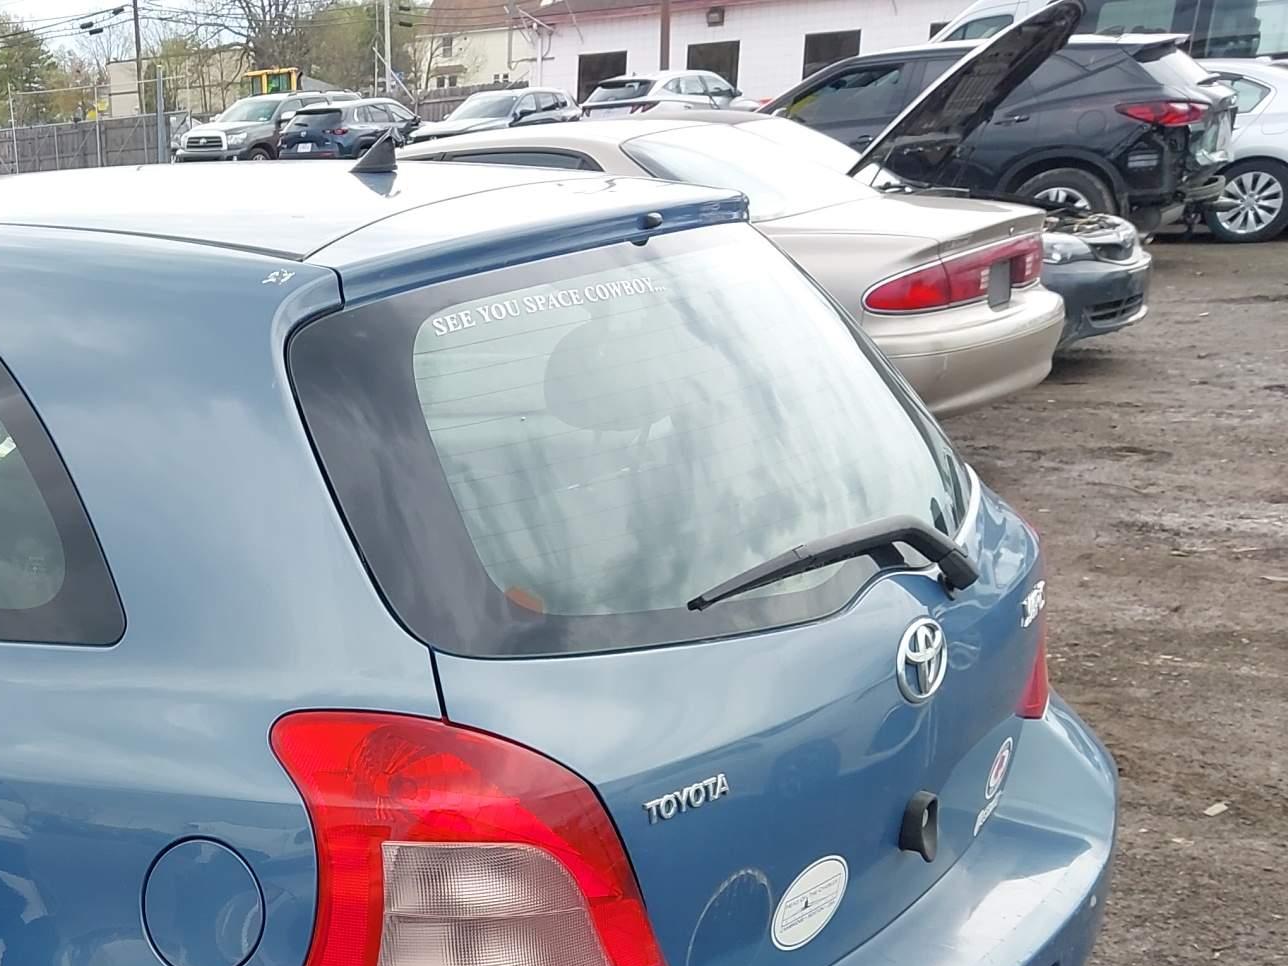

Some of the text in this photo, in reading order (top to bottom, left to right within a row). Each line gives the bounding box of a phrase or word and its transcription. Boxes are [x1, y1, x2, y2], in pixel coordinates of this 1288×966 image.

[432, 310, 475, 336] SEE
[476, 300, 521, 323] YOU
[523, 289, 583, 314] SPACE
[642, 773, 729, 825] TOYOTA
